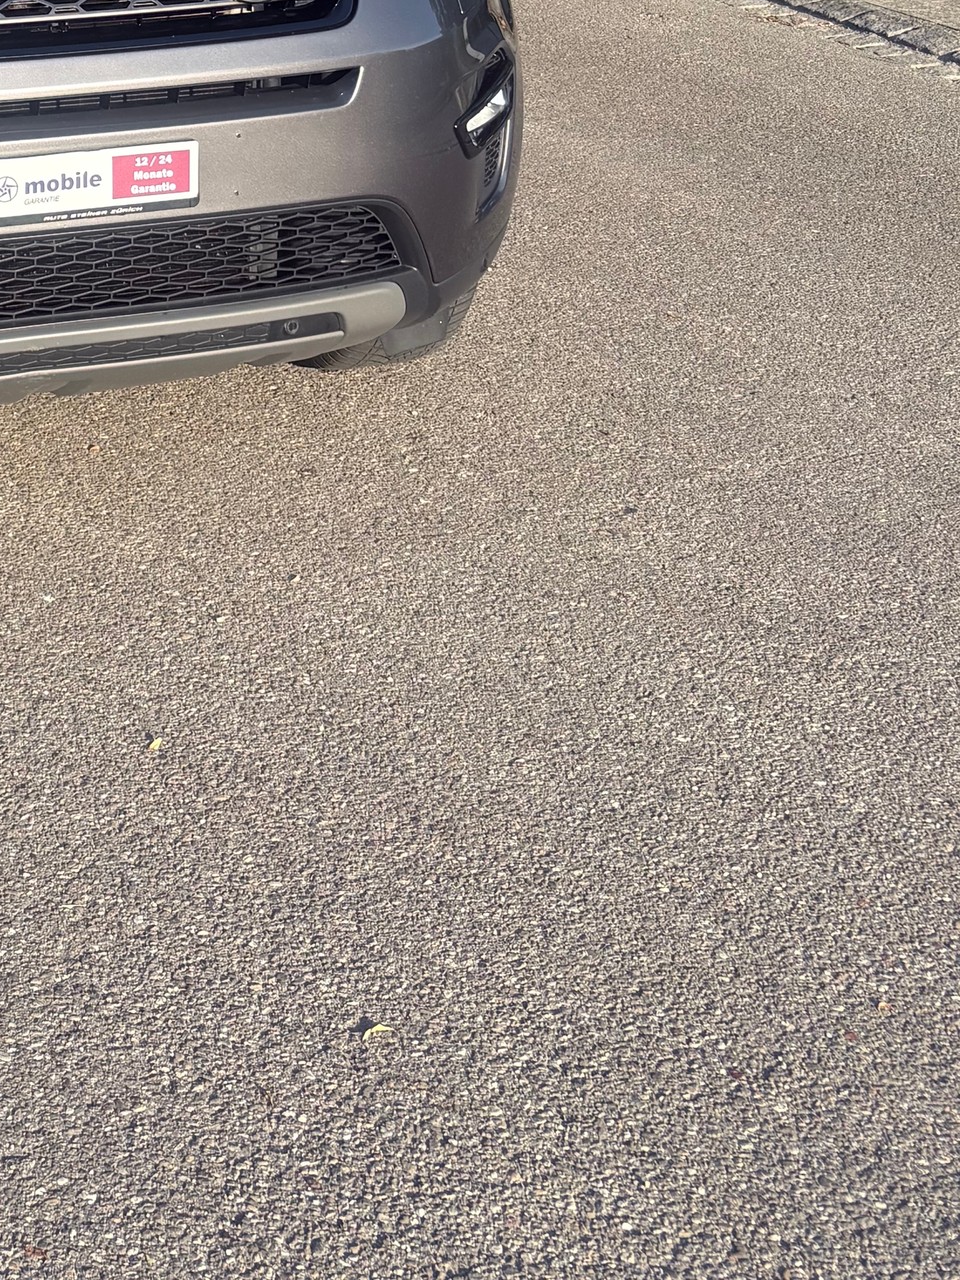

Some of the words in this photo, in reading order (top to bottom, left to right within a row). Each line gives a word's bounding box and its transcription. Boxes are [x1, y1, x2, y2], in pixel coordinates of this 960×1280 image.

[135, 156, 148, 167] 12
[158, 154, 172, 165] 24
[133, 168, 174, 181] Monate
[24, 171, 102, 195] mobile
[130, 181, 176, 195] Garantie
